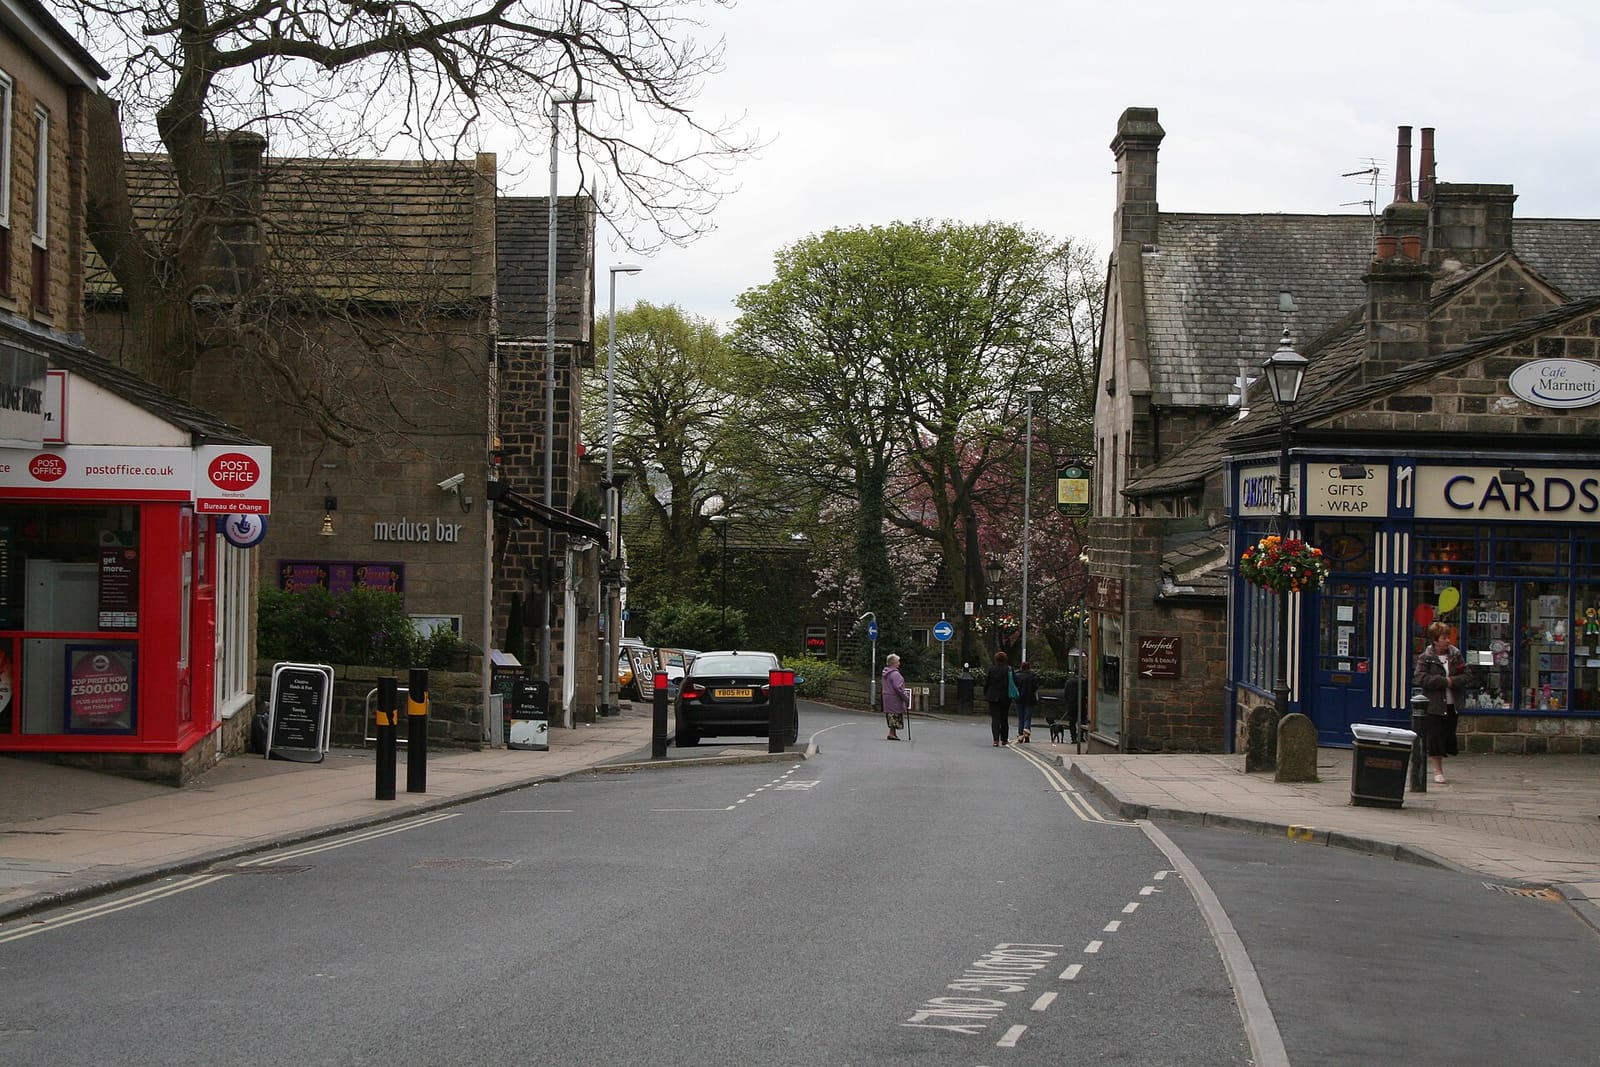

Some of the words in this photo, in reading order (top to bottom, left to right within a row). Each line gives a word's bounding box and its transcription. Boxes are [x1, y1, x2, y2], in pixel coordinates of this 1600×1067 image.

[1541, 366, 1567, 379] Café
[1540, 379, 1595, 391] Marinetti
[38, 459, 59, 467] POST
[220, 461, 250, 471] POST
[32, 467, 62, 475] OFFICE
[86, 465, 174, 477] postoffice.co.uk
[213, 471, 254, 482] OFFICE
[1328, 484, 1364, 496] GIFTS
[1444, 475, 1599, 513] CARDS
[204, 502, 227, 510] Bureau
[239, 503, 262, 512] Change
[1327, 501, 1369, 512] WRAP
[374, 517, 430, 542] medusa
[436, 517, 463, 542] bar
[103, 557, 116, 565] get
[1142, 637, 1178, 657] Horsforth
[71, 683, 129, 696] £500,000
[946, 943, 1065, 993] LOADING
[900, 997, 1008, 1035] ONLY
